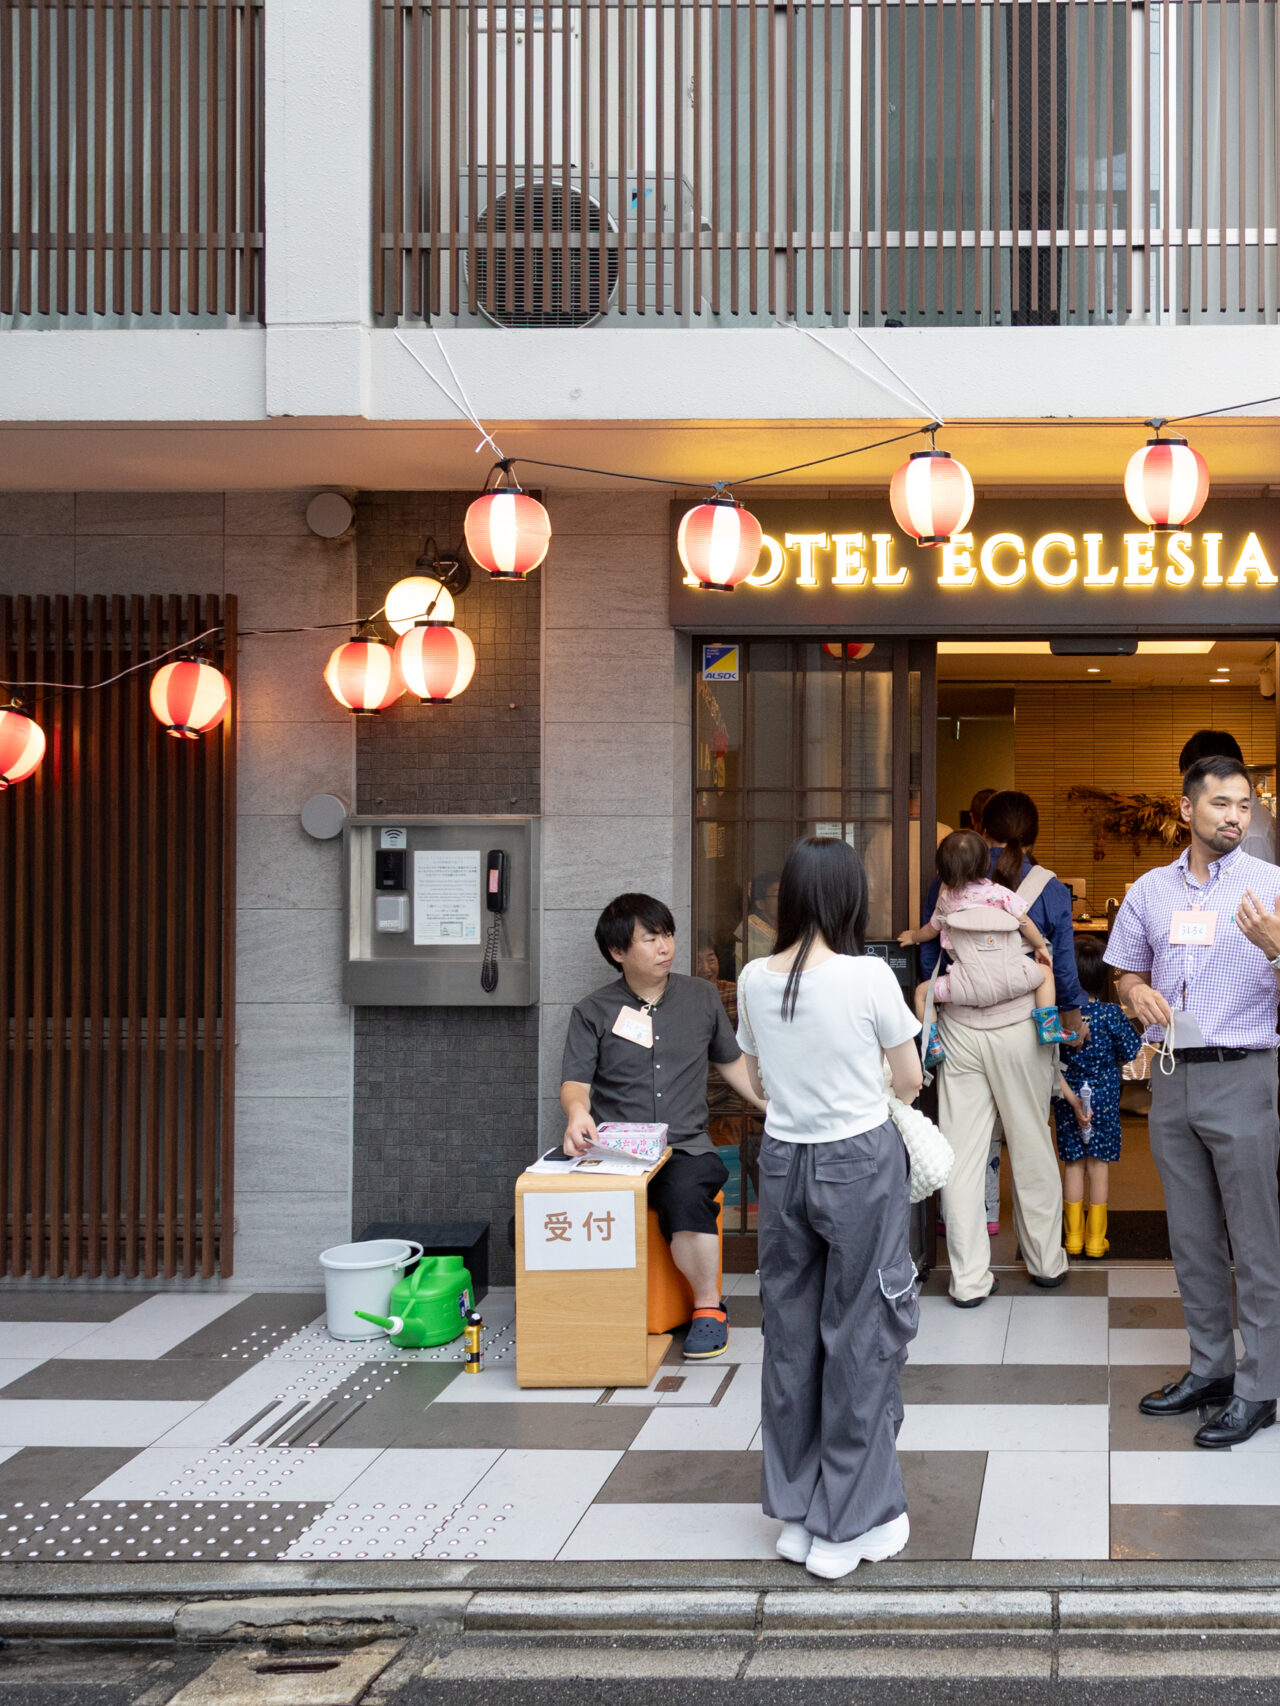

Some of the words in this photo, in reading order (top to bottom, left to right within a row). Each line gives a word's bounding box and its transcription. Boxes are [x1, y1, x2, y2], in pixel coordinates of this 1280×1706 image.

[683, 532, 909, 588] OTEL
[937, 532, 1280, 588] ECCLESIA
[705, 672, 737, 680] ALSOK
[544, 1210, 616, 1243] 受付
